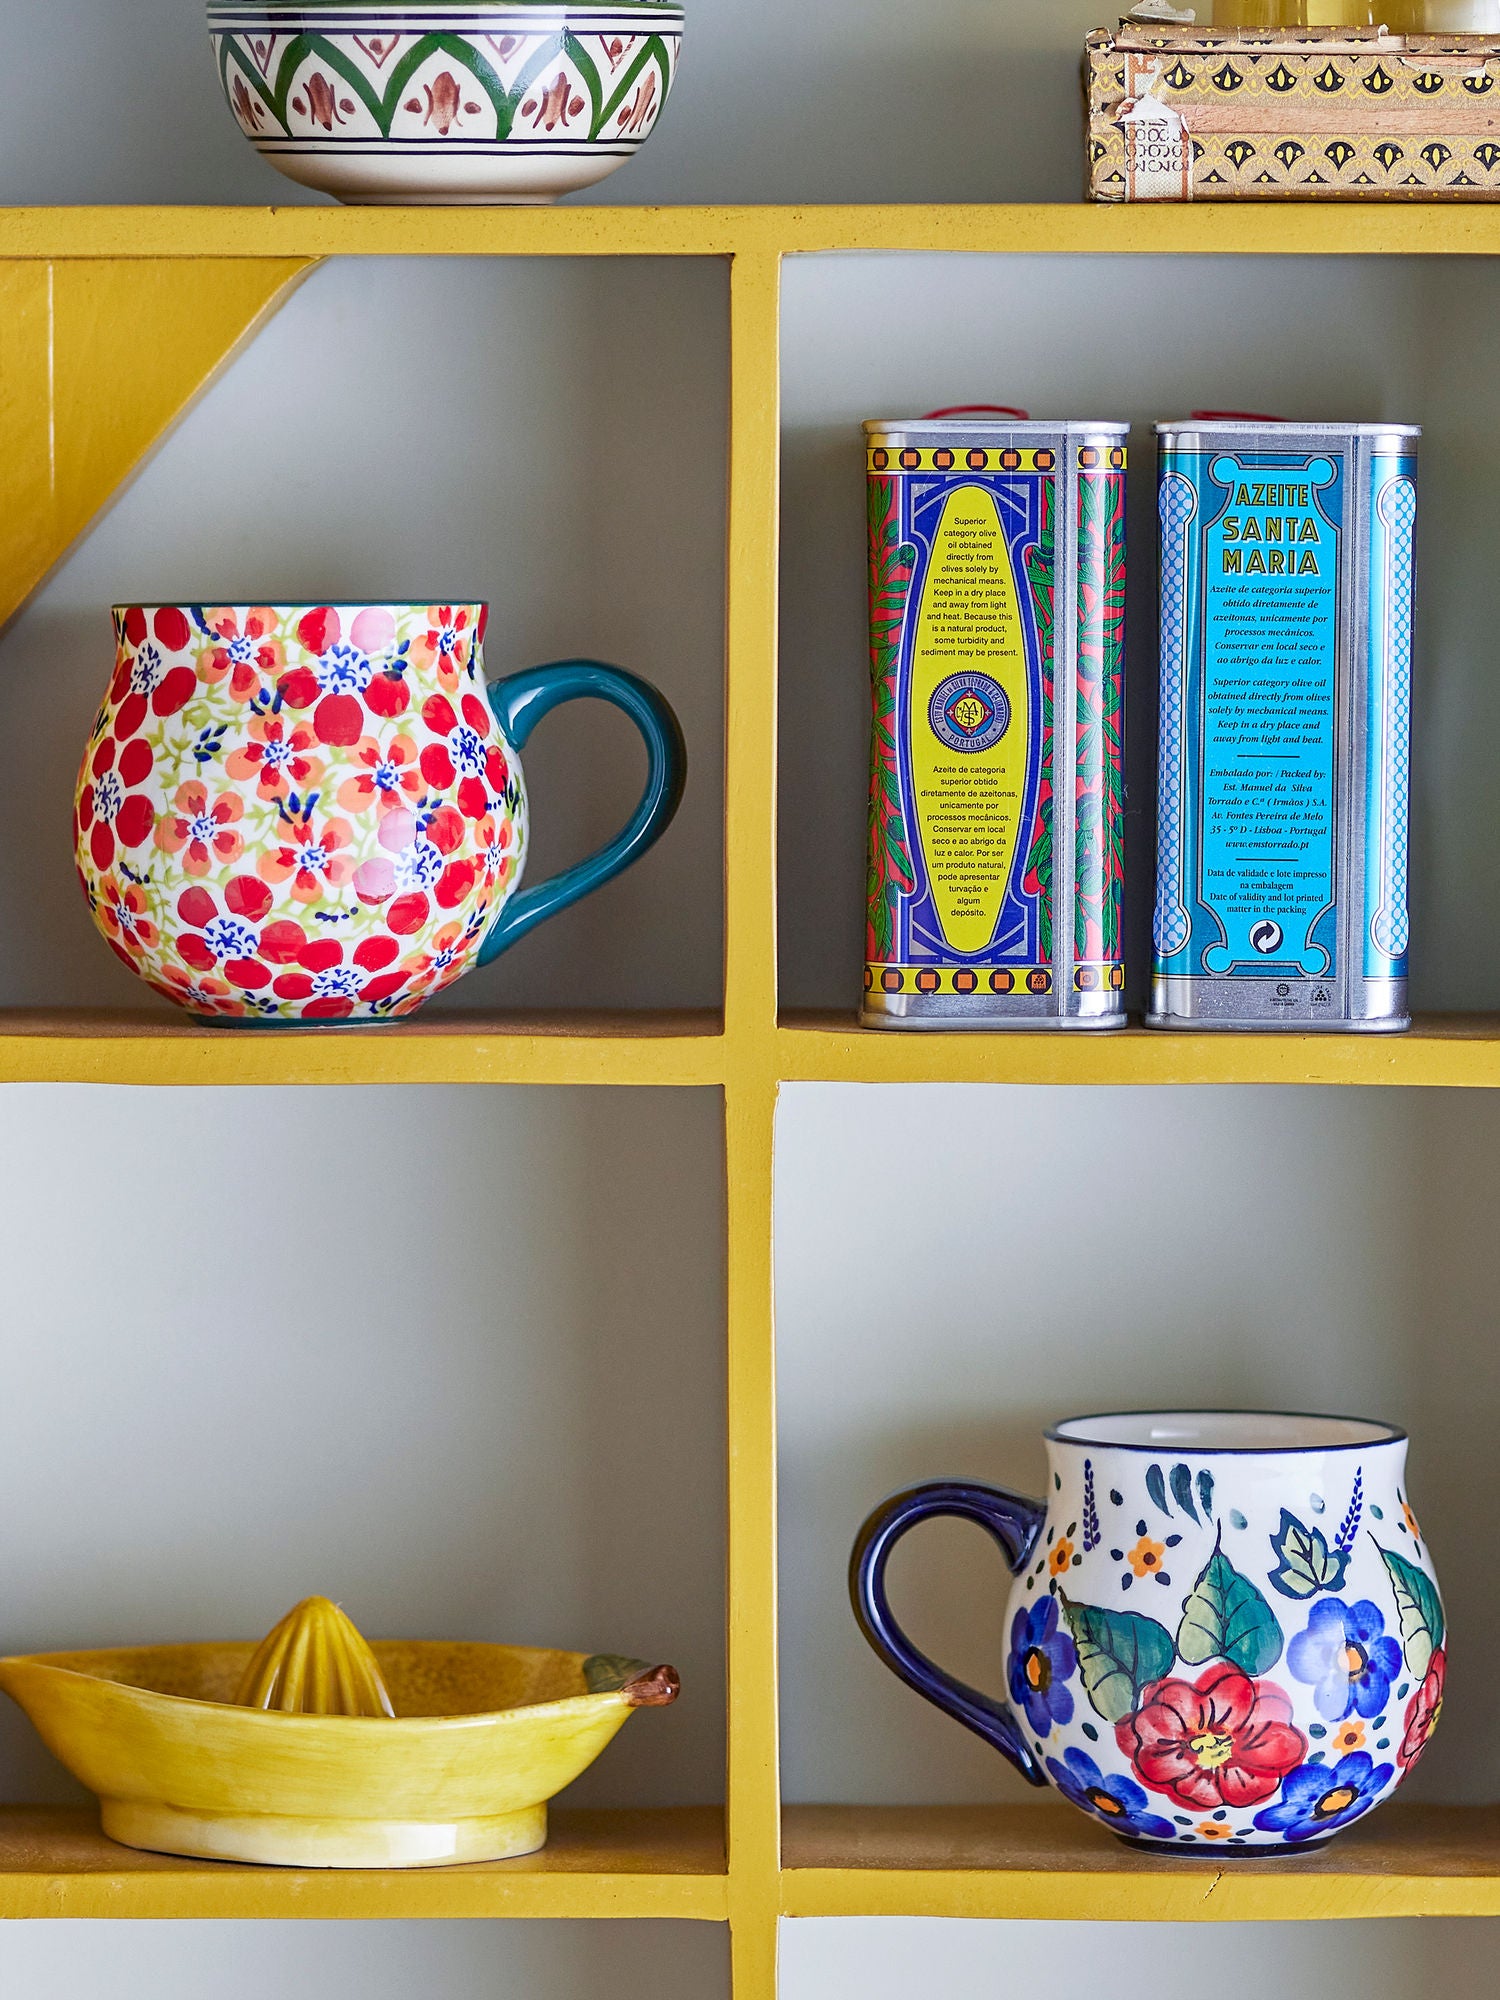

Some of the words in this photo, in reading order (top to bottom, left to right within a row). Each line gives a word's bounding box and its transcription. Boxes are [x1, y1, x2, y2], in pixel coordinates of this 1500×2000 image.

[1235, 483, 1308, 506] AZEITE
[954, 517, 987, 526] Superior
[943, 530, 977, 539] category
[978, 529, 997, 537] olive
[1223, 516, 1320, 543] SANTA
[947, 541, 957, 549] oil
[958, 541, 992, 549] obtained
[946, 553, 975, 562] directly
[976, 553, 994, 561] from
[1222, 549, 1319, 575] MARIA
[941, 565, 964, 573] olives
[965, 565, 988, 574] solely
[989, 565, 999, 574] by
[933, 577, 977, 585] mechanical
[933, 588, 954, 598] Keep
[970, 589, 984, 598] dry
[985, 589, 1006, 598] place
[1210, 585, 1237, 593] Azeite
[1238, 585, 1250, 593] de
[1251, 586, 1293, 596] categoria
[1294, 586, 1332, 596] superior
[949, 602, 969, 610] away
[990, 601, 1007, 610] light
[1222, 599, 1251, 608] obtido
[1252, 599, 1306, 609] diretamente
[1307, 600, 1319, 609] de
[964, 612, 997, 621] Because
[998, 613, 1013, 621] this
[1213, 613, 1257, 622] azeitonas,
[1260, 614, 1311, 623] unicamente
[1311, 615, 1328, 625] por
[975, 625, 1007, 634] product,
[1224, 628, 1266, 638] processos
[957, 636, 989, 646] turbidity
[1214, 642, 1260, 650] Conservar
[1276, 642, 1298, 651] local
[921, 648, 956, 656] sediment
[957, 650, 974, 658] may
[987, 649, 1018, 658] present.
[1230, 655, 1260, 666] abrigo
[1261, 656, 1273, 664] da
[1275, 656, 1289, 665] luz
[1297, 656, 1322, 665] calor.
[1213, 677, 1251, 688] Superior
[1252, 679, 1290, 689] category
[1291, 678, 1313, 687] olive
[1314, 679, 1327, 687] oil
[1207, 691, 1247, 700] obtained
[1248, 692, 1282, 703] directly
[1281, 692, 1304, 703] from
[1305, 693, 1331, 702] olives
[1208, 705, 1233, 716] solely
[1234, 705, 1245, 716] by
[1246, 706, 1297, 715] mechanical
[1217, 720, 1239, 730] Keep
[1240, 720, 1250, 728] in
[1259, 720, 1276, 731] dry
[1276, 720, 1301, 731] place
[1302, 721, 1321, 730] and
[948, 734, 991, 747] PORTUGAL
[1213, 736, 1237, 744] away
[1236, 734, 1259, 744] from
[1261, 734, 1281, 745] light
[1282, 735, 1301, 743] and
[932, 765, 957, 773] Azeite
[958, 766, 969, 774] de
[970, 766, 1006, 775] categoria
[1209, 768, 1254, 777] Embalado
[1255, 770, 1273, 779] por:
[1280, 769, 1312, 778] Packed
[1313, 769, 1326, 780] by:
[940, 778, 972, 787] superior
[973, 778, 998, 786] obtido
[1240, 783, 1273, 792] Manuel
[1274, 783, 1287, 792] da
[1291, 783, 1313, 792] Silva
[920, 789, 966, 797] diretamente
[979, 790, 1018, 798] azeitonas,
[939, 801, 984, 809] unicamente
[985, 803, 999, 811] por
[1208, 797, 1243, 805] Torrado
[927, 814, 966, 822] processos
[1226, 811, 1254, 820] Fontes
[1255, 812, 1288, 820] Pereira
[1289, 812, 1301, 821] de
[1302, 812, 1324, 821] Melo
[932, 825, 972, 833] Conservar
[987, 825, 1006, 833] local
[1210, 825, 1222, 835] 35
[1254, 825, 1283, 834] Lisboa
[1289, 826, 1327, 837] Portugal
[970, 837, 995, 847] abrigo
[996, 837, 1007, 845] da
[934, 849, 946, 857] luz
[953, 849, 975, 857] calor.
[976, 849, 990, 857] Por
[945, 861, 976, 870] produto
[977, 861, 1006, 870] natural,
[938, 873, 958, 882] pode
[959, 874, 1000, 882] apresentar
[1207, 868, 1225, 877] Data
[1226, 868, 1236, 877] de
[1237, 868, 1269, 878] validade
[1276, 869, 1291, 878] lote
[1293, 870, 1327, 880] impresso
[948, 885, 982, 894] turvação
[1251, 881, 1294, 891] embalagem
[957, 897, 980, 906] algum
[1210, 892, 1228, 901] Date
[1229, 892, 1238, 901] of
[1238, 892, 1266, 903] validity
[1267, 893, 1282, 901] and
[1284, 893, 1294, 902] lot
[1296, 893, 1324, 904] printed
[950, 909, 986, 918] depósito.
[1253, 905, 1261, 913] in
[1263, 905, 1276, 913] the
[1277, 905, 1307, 916] packing
